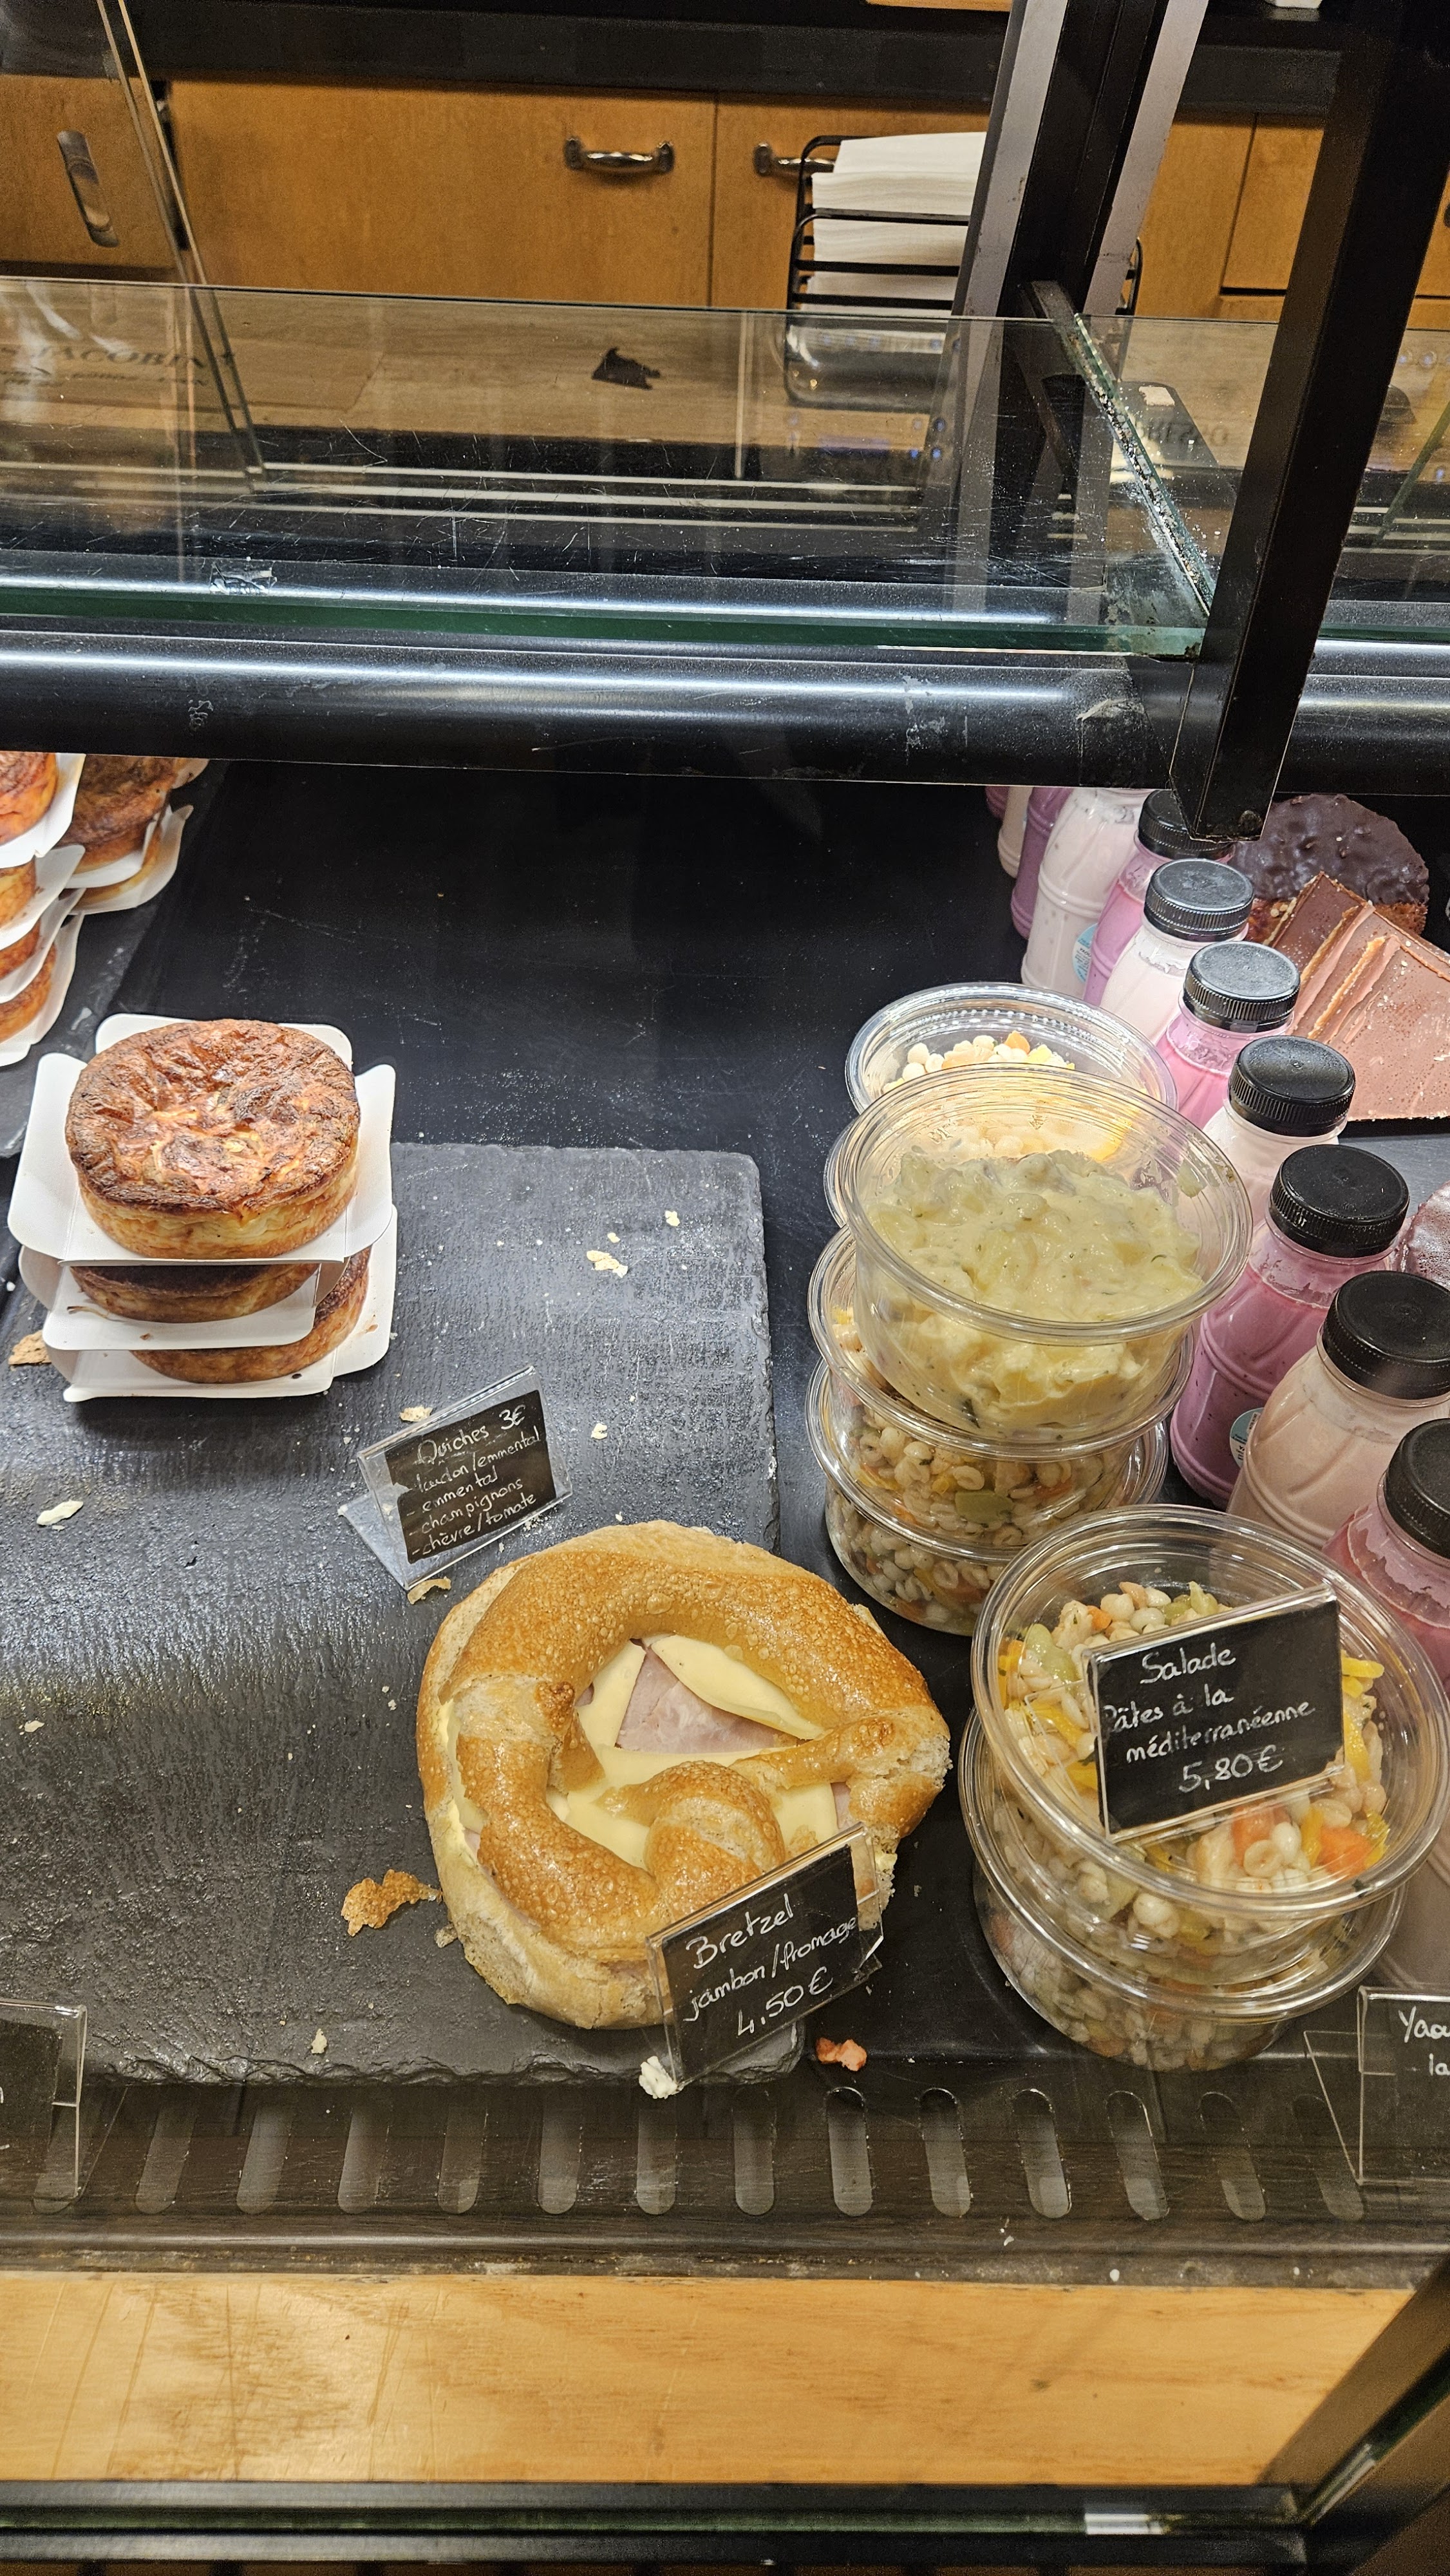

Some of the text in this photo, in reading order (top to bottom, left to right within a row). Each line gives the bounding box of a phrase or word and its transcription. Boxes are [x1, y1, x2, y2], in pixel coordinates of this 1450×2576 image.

[413, 1404, 526, 1465] Quiches 3€
[1140, 1642, 1236, 1685] Salade
[1172, 1693, 1194, 1716] à
[1203, 1683, 1234, 1707] la
[1126, 1700, 1316, 1764] méditerranéenne
[1178, 1744, 1283, 1794] 5,80€
[686, 1893, 795, 1969] Bretzel
